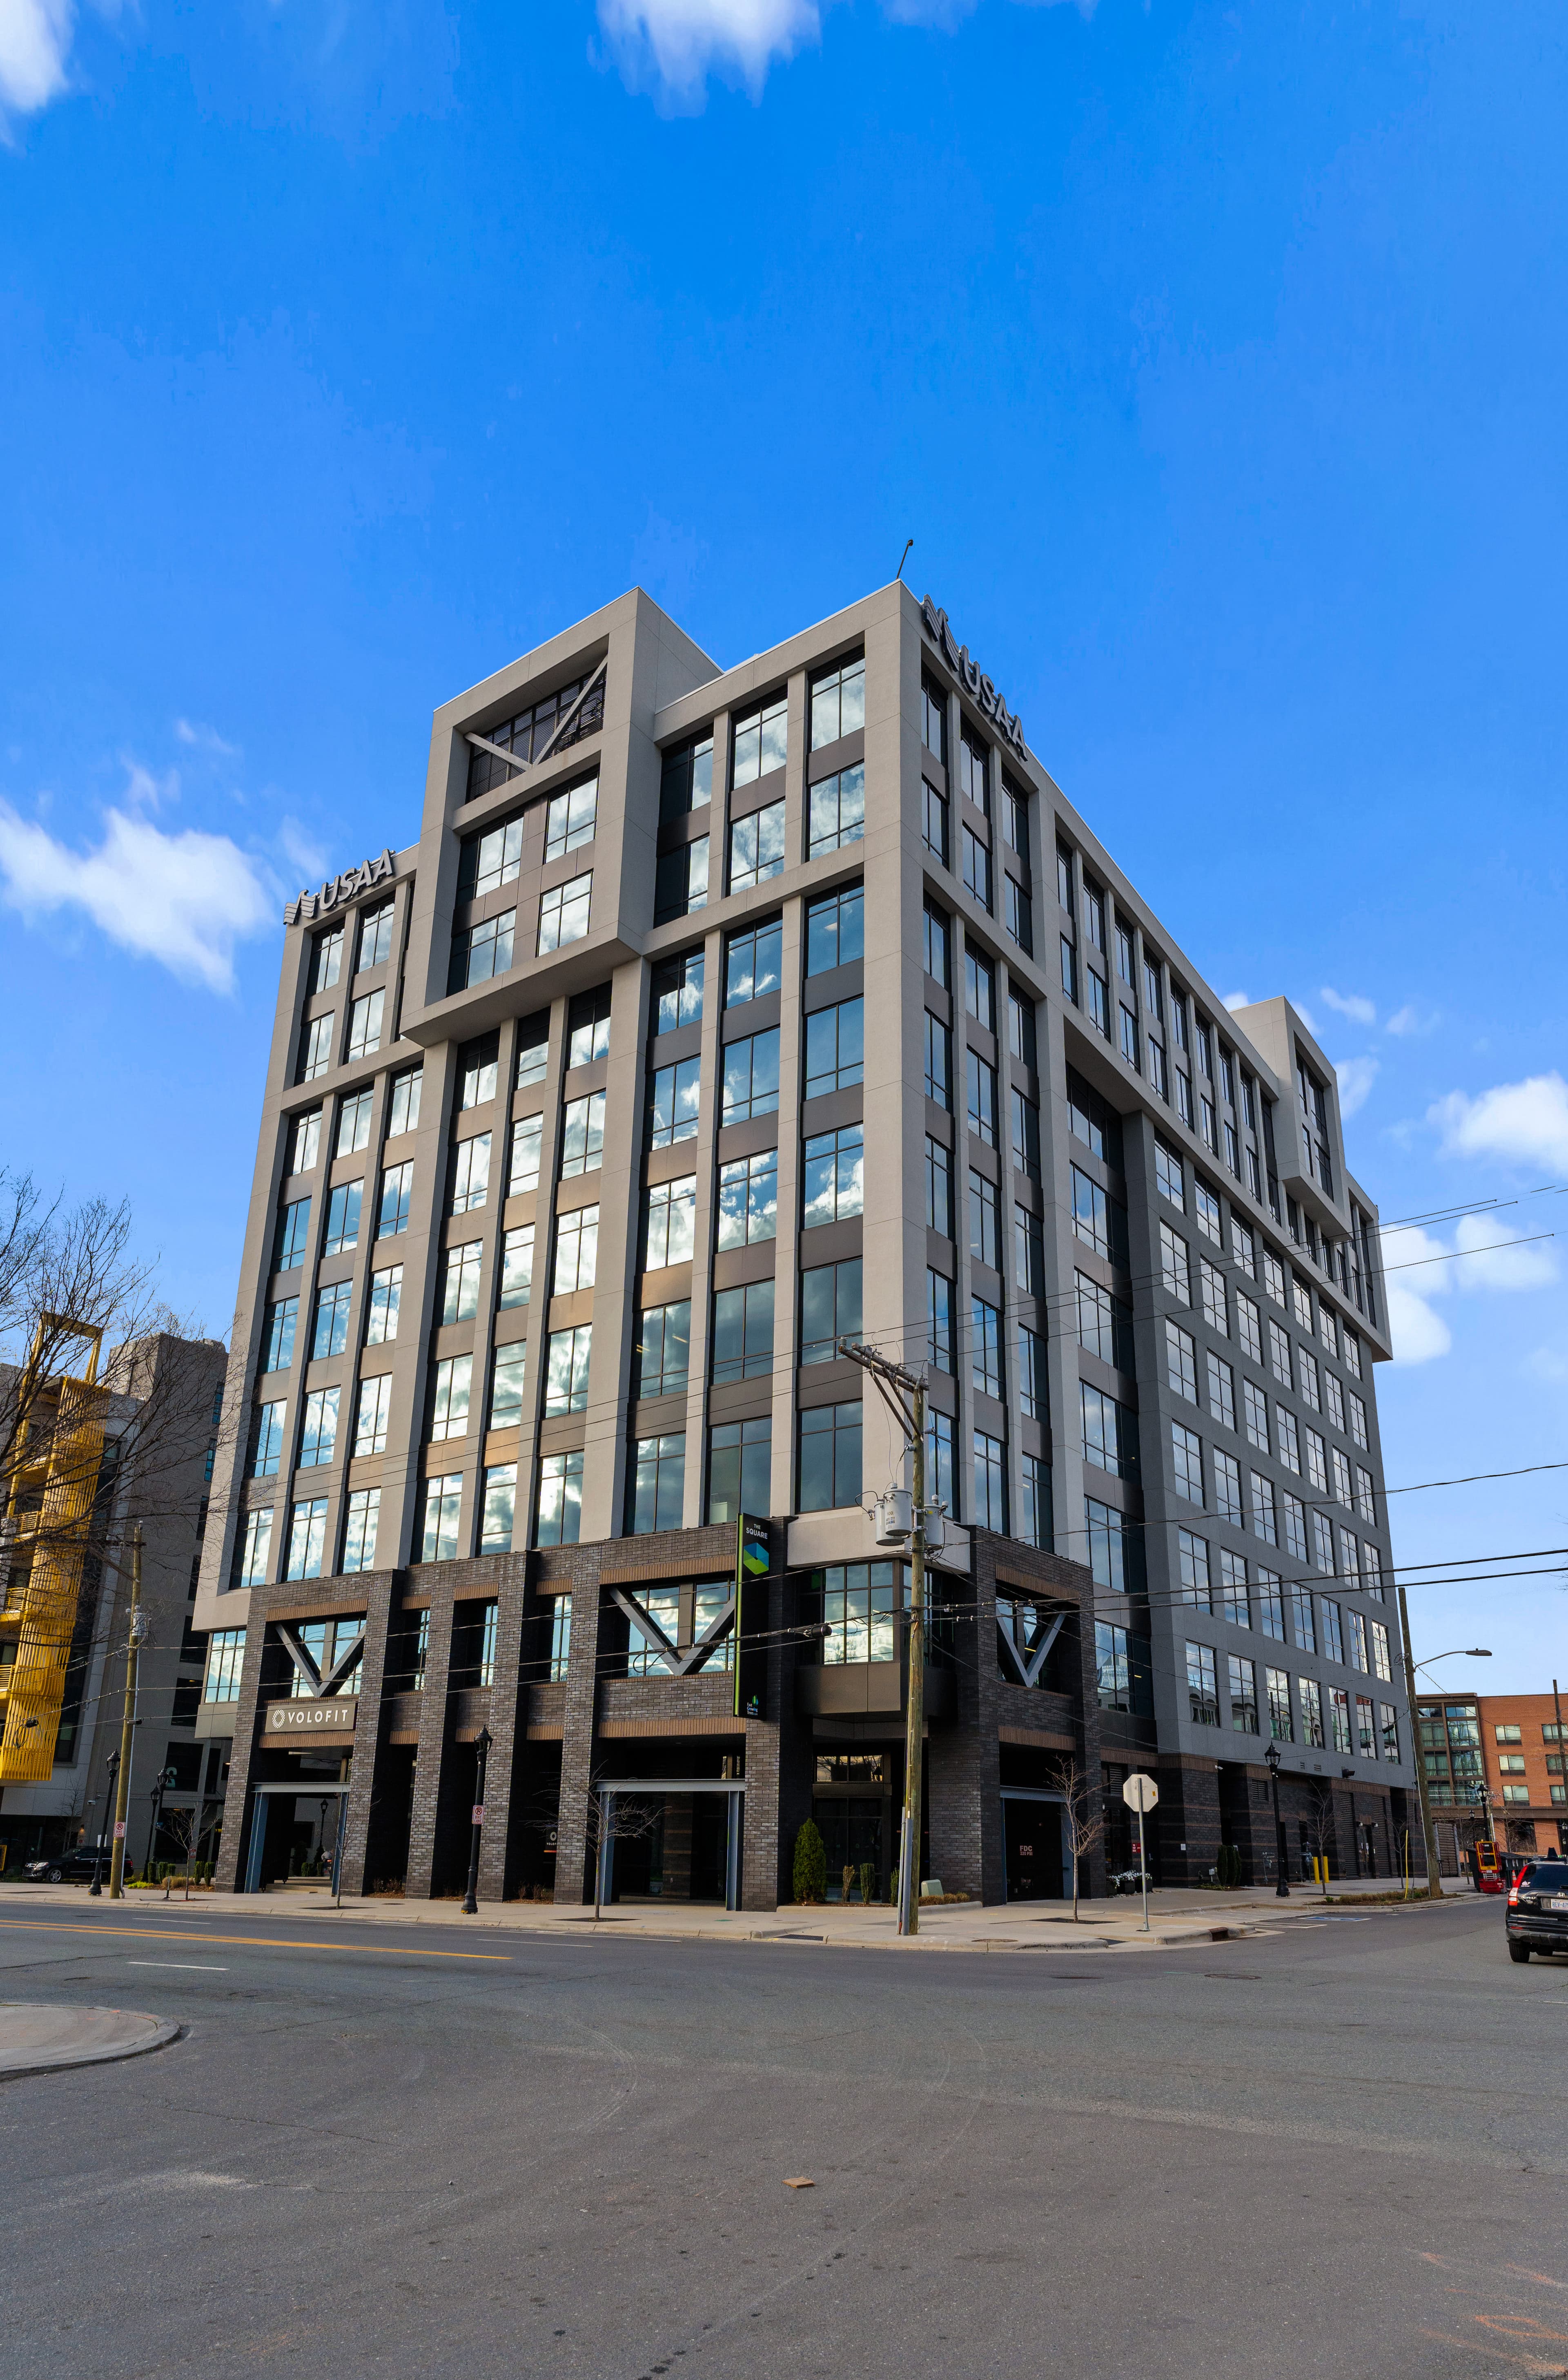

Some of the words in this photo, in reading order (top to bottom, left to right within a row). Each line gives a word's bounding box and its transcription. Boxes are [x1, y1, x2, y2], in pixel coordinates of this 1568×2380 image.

[960, 644, 1028, 762] USAA
[319, 848, 394, 910] USAA
[746, 1527, 768, 1539] SQUARE
[287, 1709, 348, 1724] VOLOFIT
